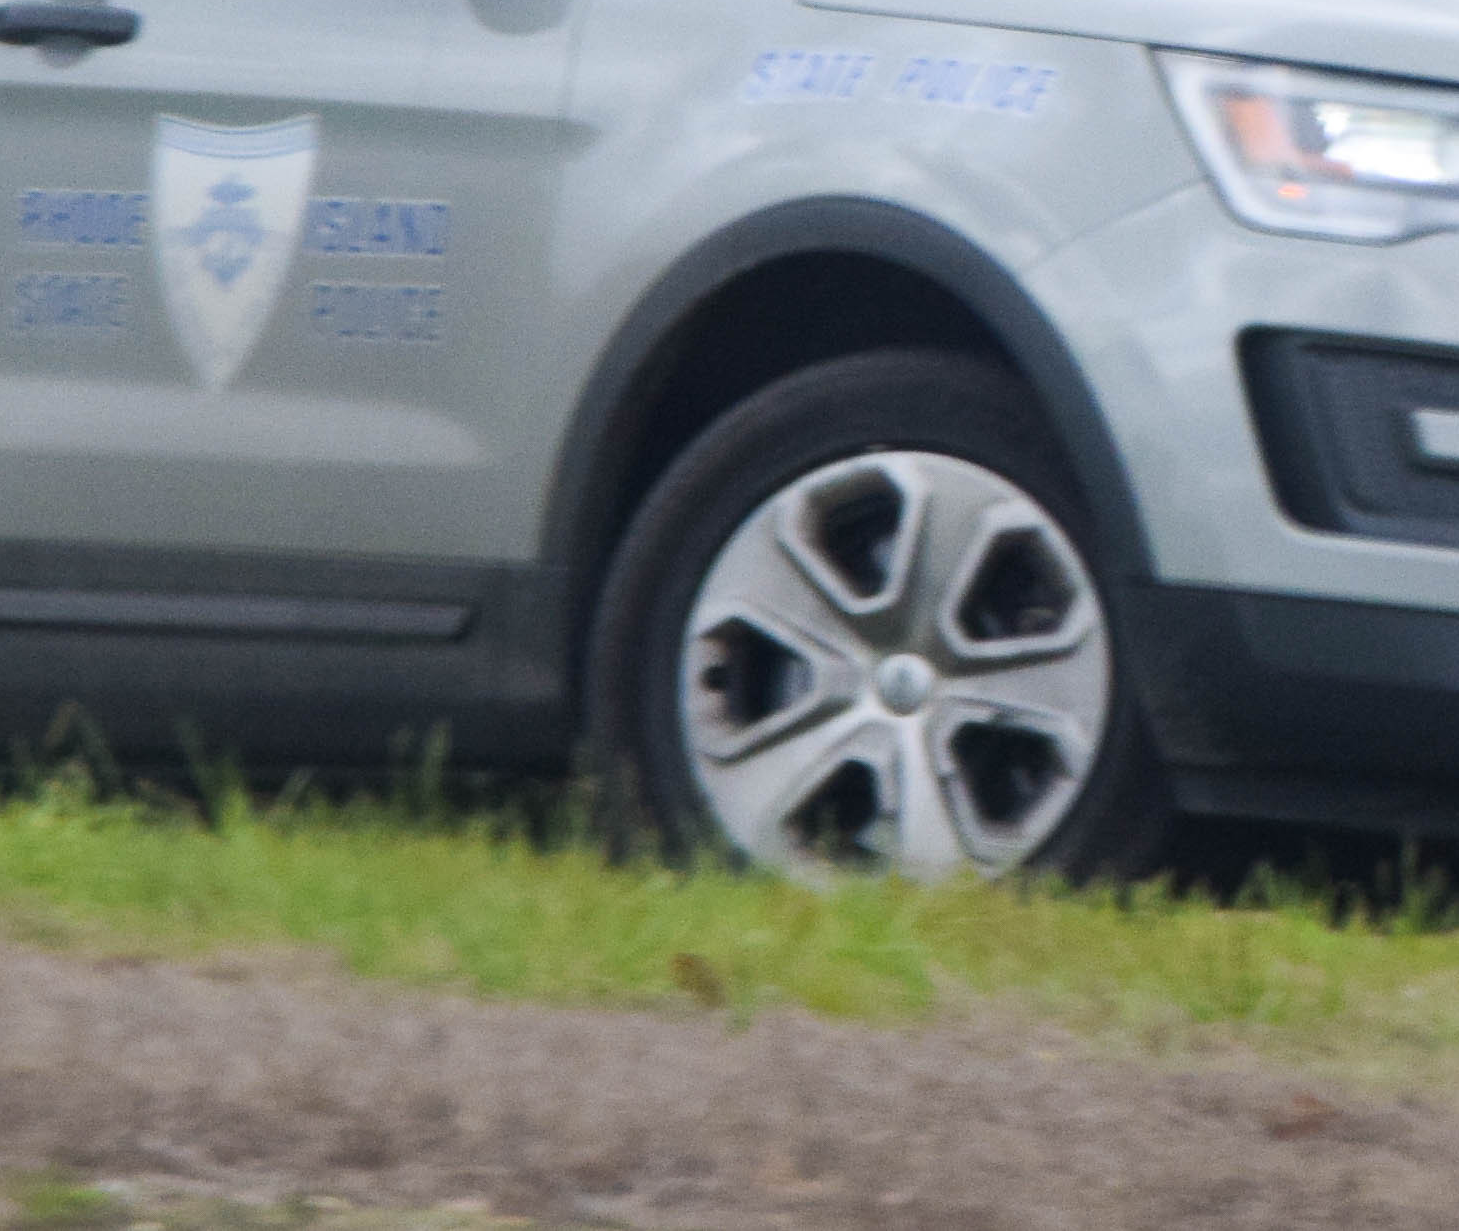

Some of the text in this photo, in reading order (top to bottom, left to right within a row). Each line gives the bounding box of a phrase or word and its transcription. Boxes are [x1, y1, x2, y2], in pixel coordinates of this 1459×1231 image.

[742, 50, 1058, 118] STATE POLICE
[17, 190, 451, 257] RHODE ISLAND
[309, 280, 446, 344] POLICE
